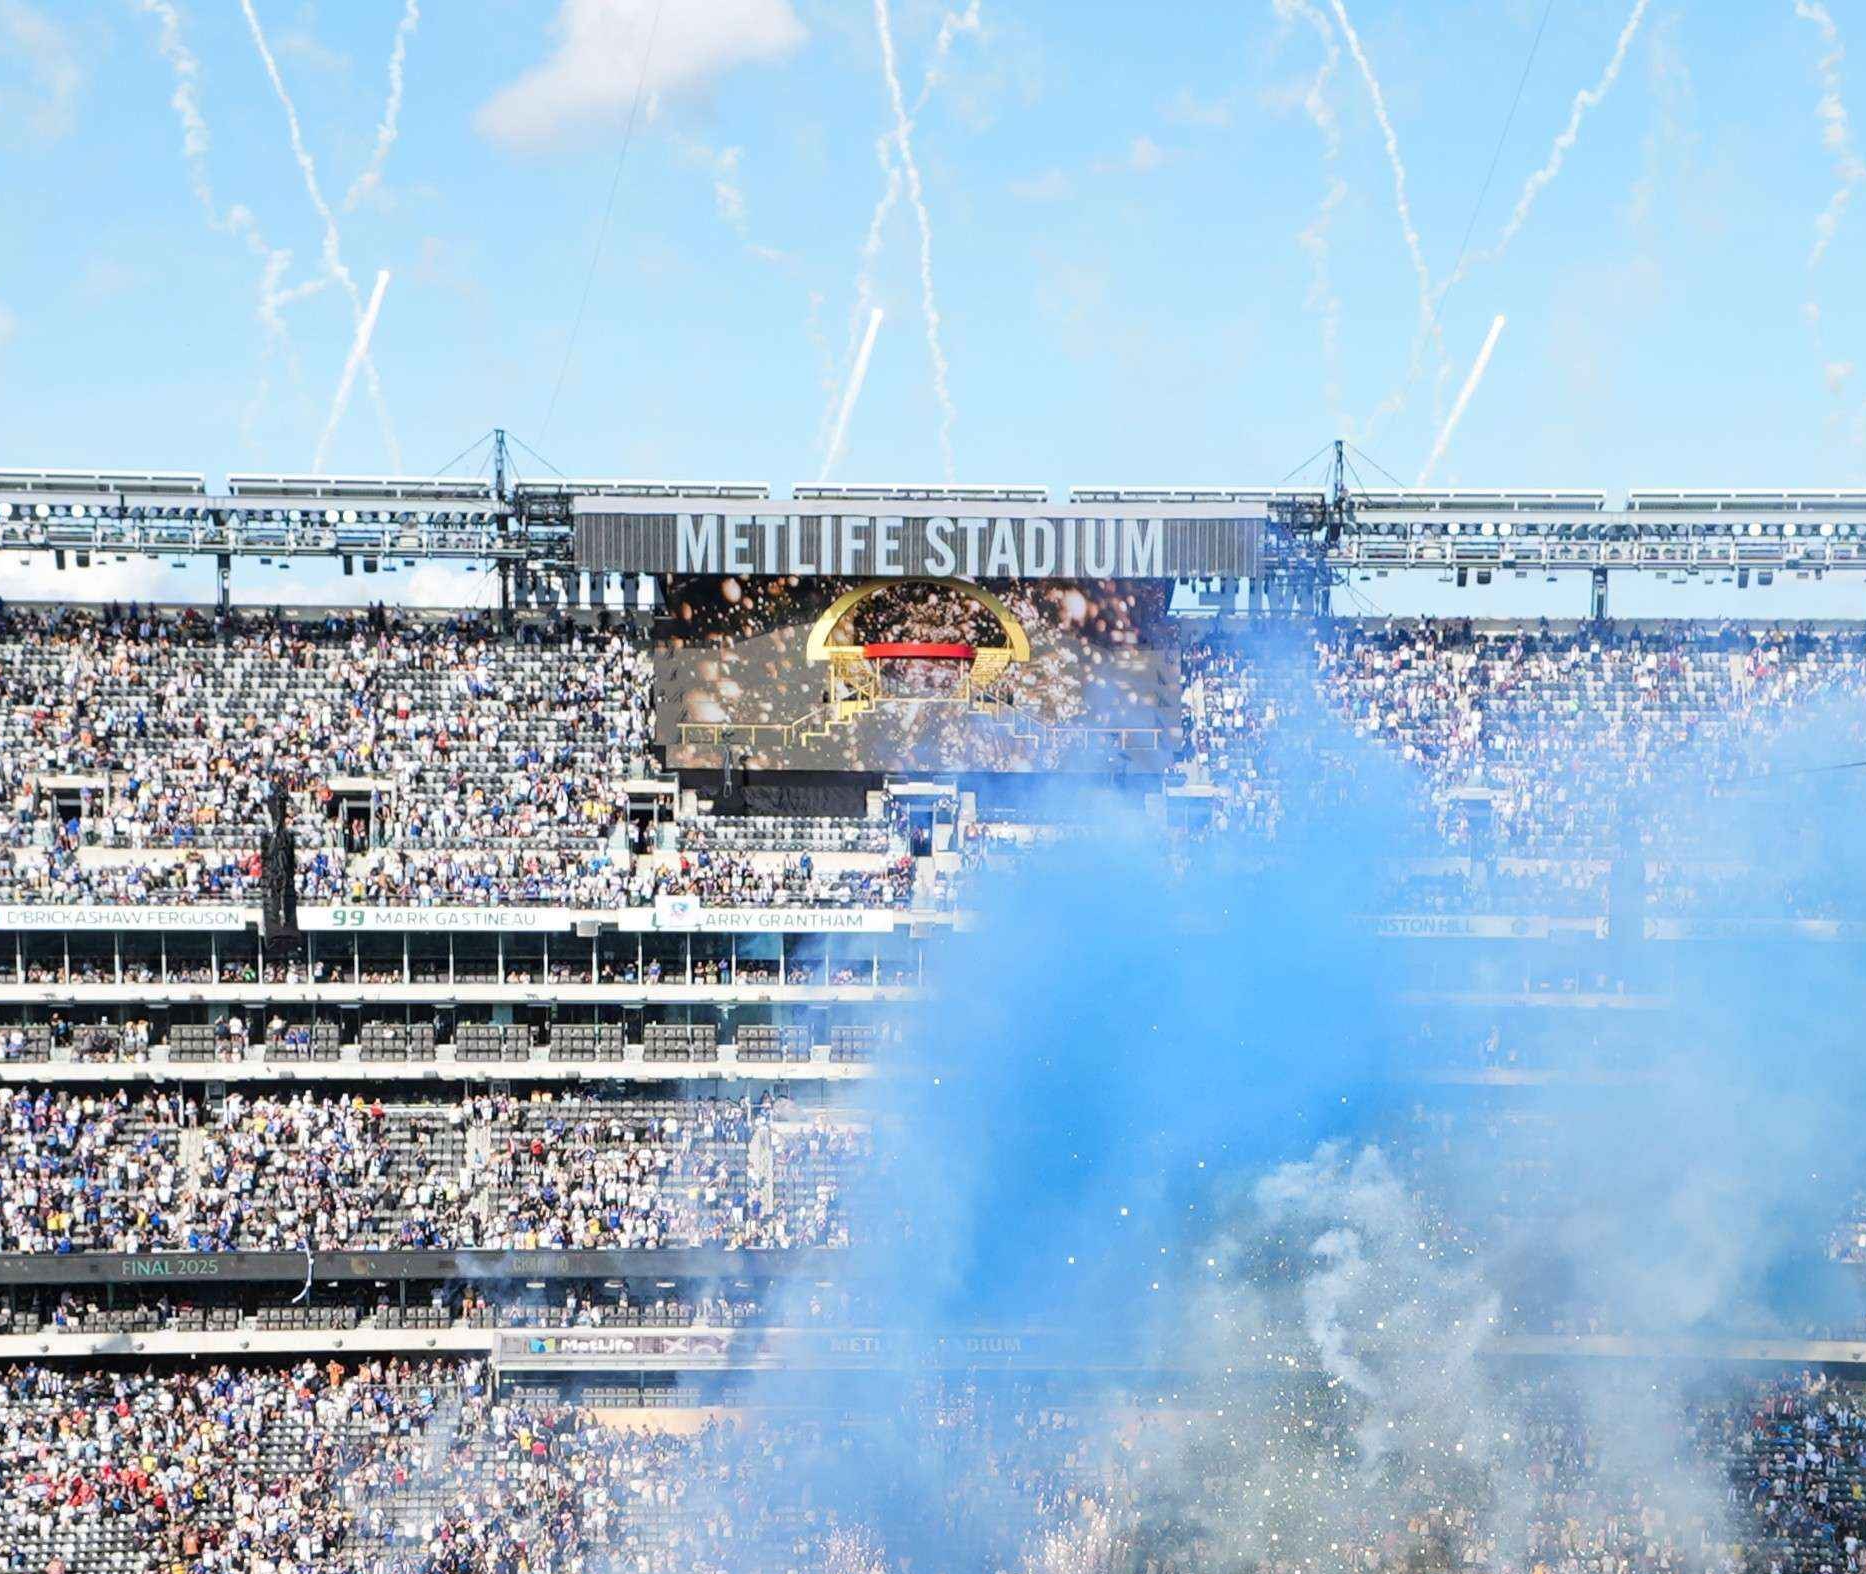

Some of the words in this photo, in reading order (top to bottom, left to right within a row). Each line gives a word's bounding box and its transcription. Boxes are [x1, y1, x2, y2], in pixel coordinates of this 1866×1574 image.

[677, 513, 903, 575] METLIFE
[924, 516, 1163, 578] STADIUM
[146, 910, 240, 925] FERGUSON
[332, 910, 365, 926] 99
[374, 911, 429, 926] MARK
[434, 911, 536, 926] GASTINEAU
[703, 913, 753, 927] ARRY
[757, 913, 863, 928] GRANTHAM
[122, 1260, 175, 1276] FINAL
[178, 1259, 219, 1275] 2025
[561, 1338, 635, 1352] MetLife
